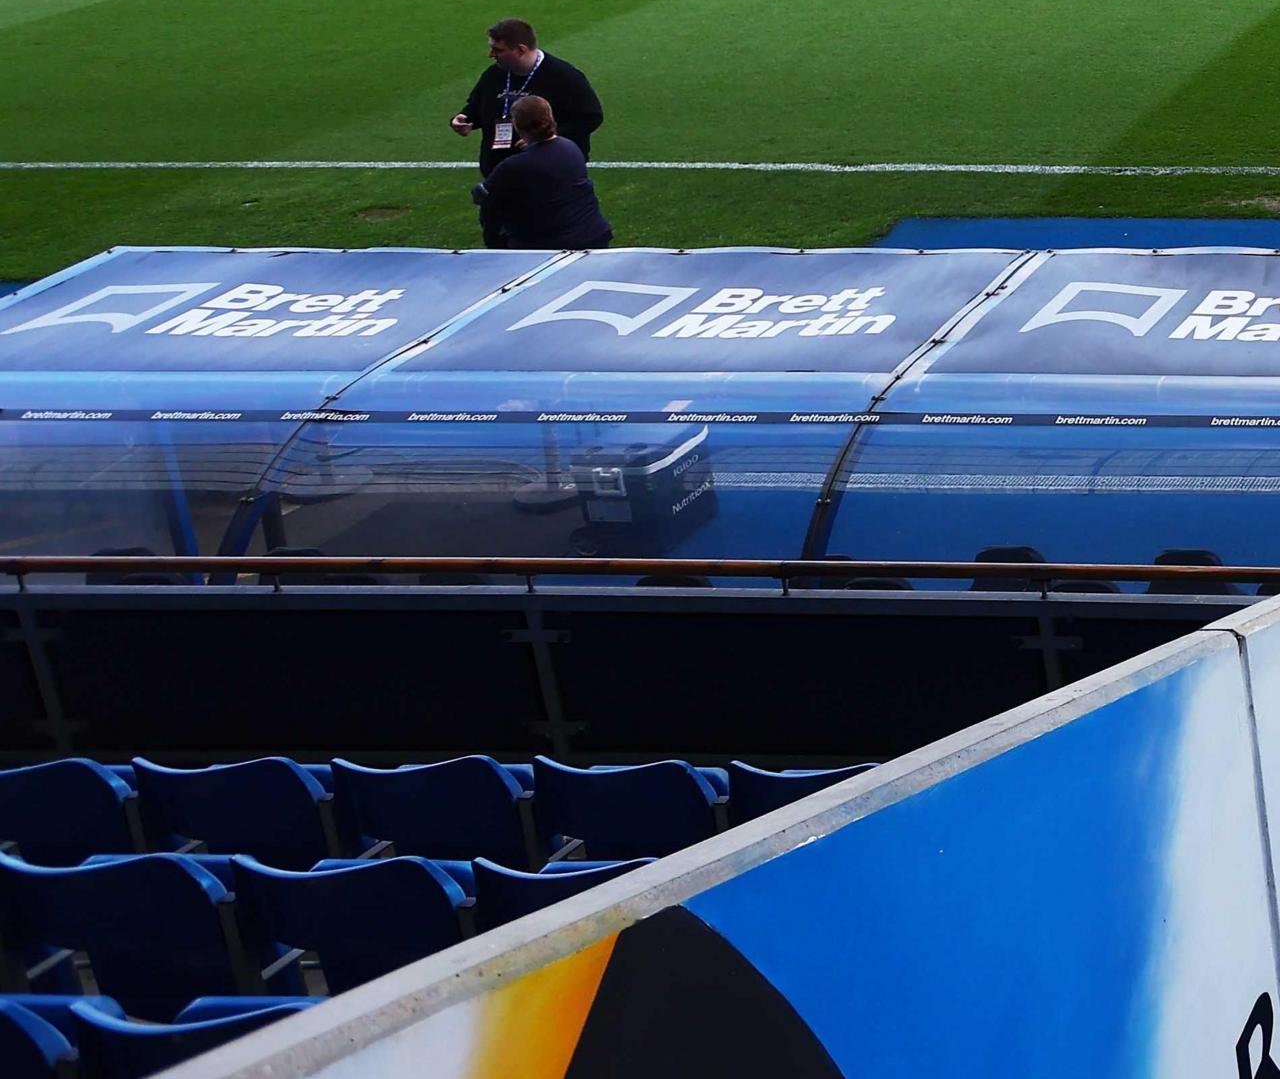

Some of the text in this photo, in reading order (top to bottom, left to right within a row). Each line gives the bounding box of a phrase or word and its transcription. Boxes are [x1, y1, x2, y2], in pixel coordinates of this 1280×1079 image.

[200, 282, 408, 314] Brett
[693, 283, 887, 314] Brett
[146, 308, 400, 340] Martin
[651, 310, 896, 341] Martin
[21, 411, 112, 420] brettmartin.com
[150, 411, 241, 420] brettmartin.com
[280, 411, 370, 420] brettmartin.com
[408, 413, 497, 421] brettmartin.com
[537, 413, 627, 421] brettmartin.com
[667, 413, 757, 422] brettmartin.com
[789, 414, 880, 422] brettmartin.com
[922, 414, 1013, 423] brettmartin.com
[1055, 416, 1147, 424] brettmartin.com
